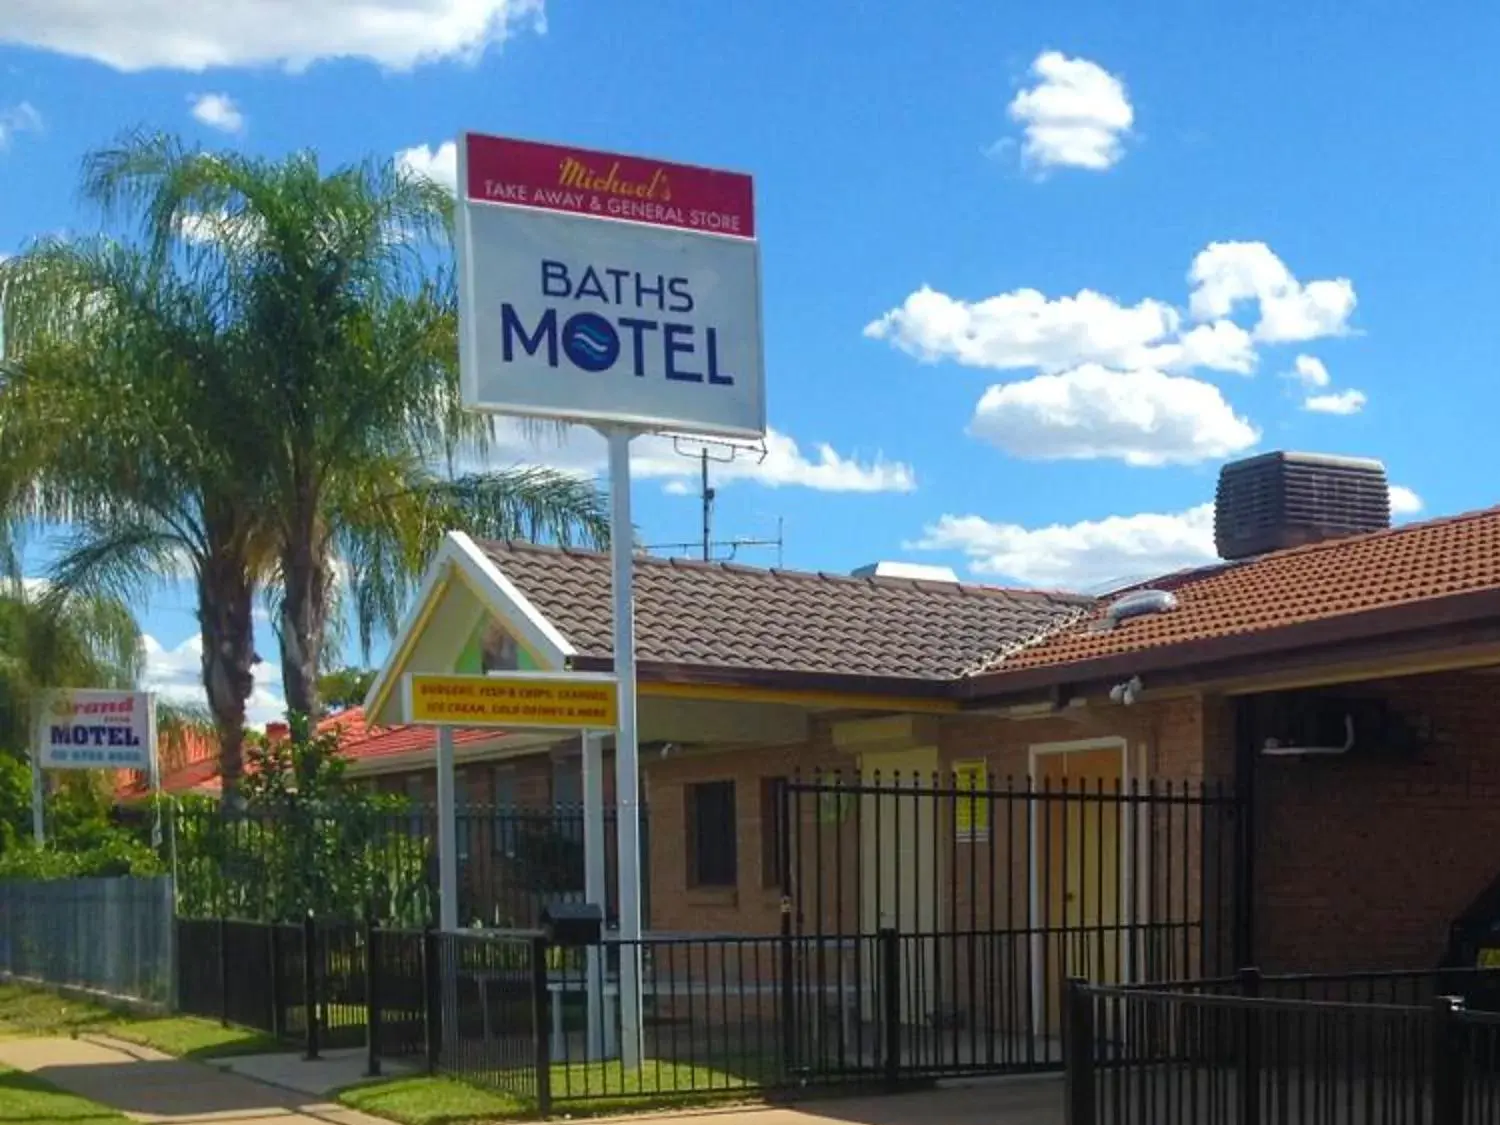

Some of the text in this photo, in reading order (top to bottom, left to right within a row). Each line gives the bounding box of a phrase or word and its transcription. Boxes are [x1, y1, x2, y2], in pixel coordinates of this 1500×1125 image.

[559, 155, 672, 202] Michael's
[484, 180, 741, 232] TAKE AWAY & GENERAL STORE
[541, 260, 693, 313] BATHS
[501, 303, 734, 386] MOTEL
[51, 725, 140, 747] MOTEL
